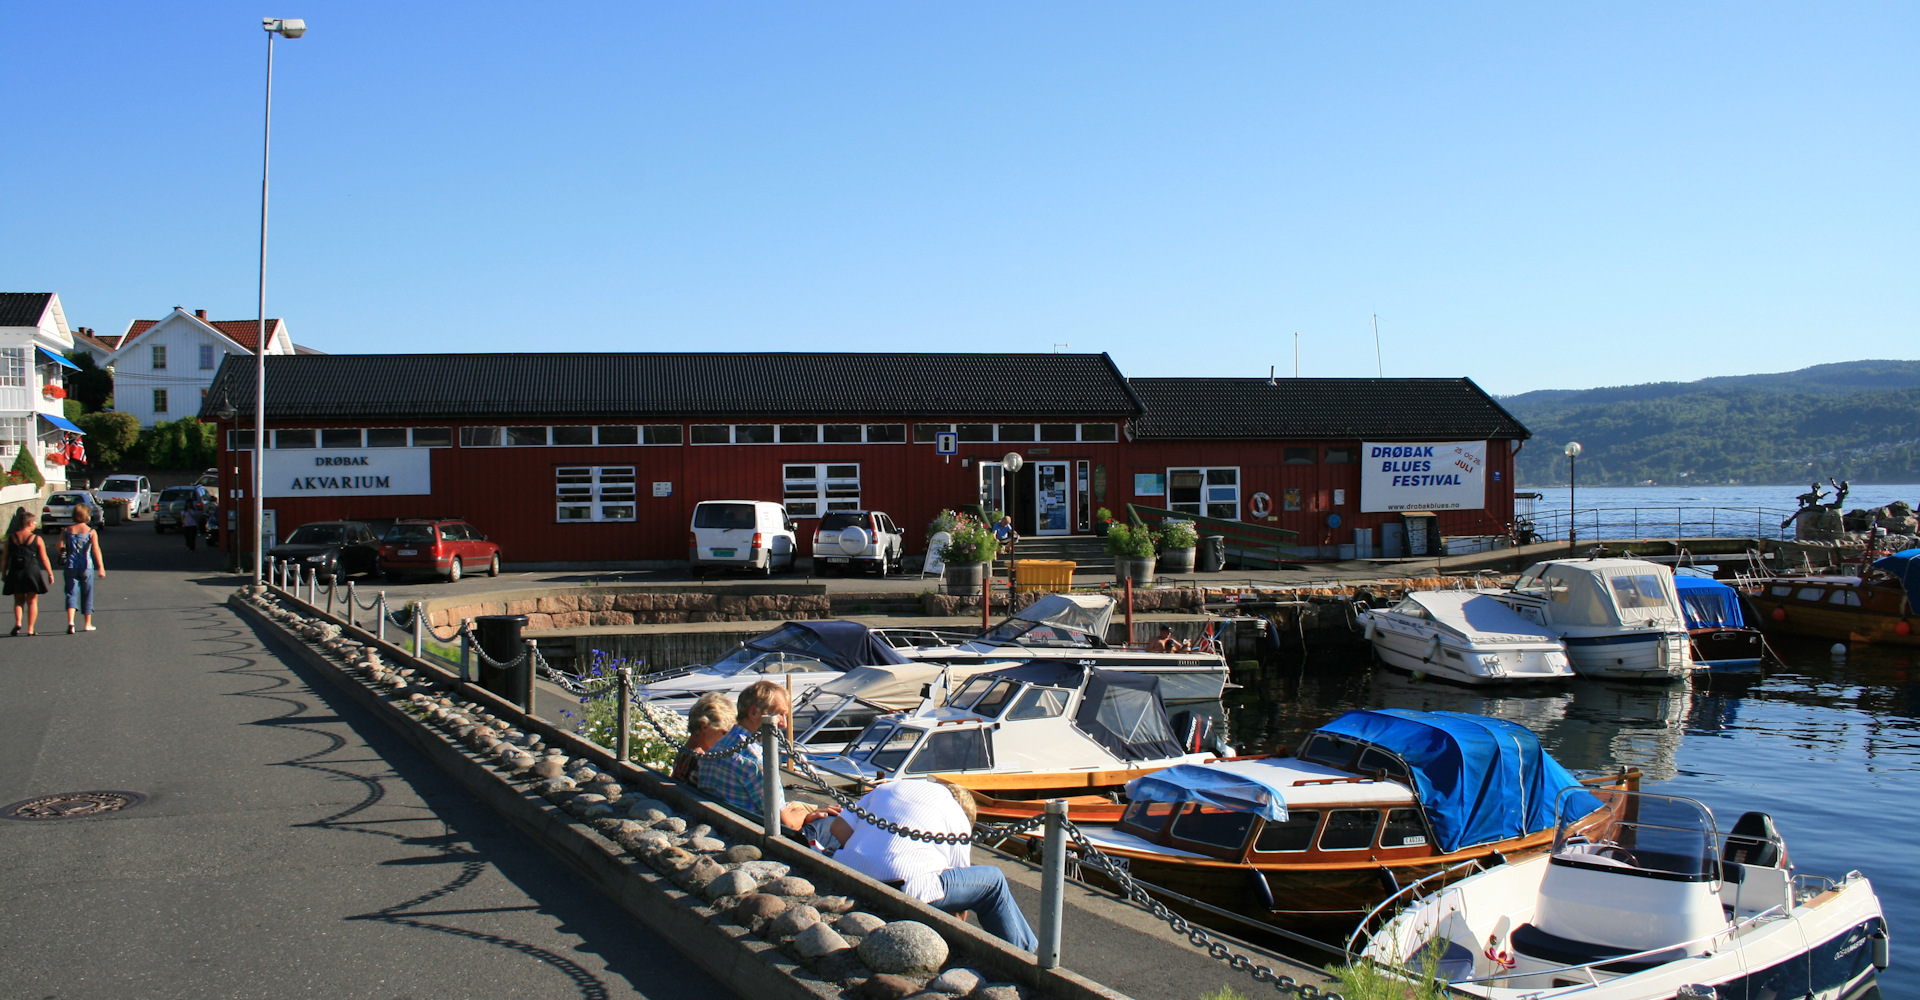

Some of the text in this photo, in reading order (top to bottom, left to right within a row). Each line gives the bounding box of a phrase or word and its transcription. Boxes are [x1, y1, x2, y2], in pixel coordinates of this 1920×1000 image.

[1371, 446, 1434, 459] DRØBAK
[1463, 452, 1473, 461] OG
[315, 456, 369, 466] DRØBAK
[1382, 461, 1431, 473] BLUES
[1454, 459, 1474, 473] JULI
[291, 476, 390, 490] AKVARIUM
[1392, 474, 1461, 487] FESTIVAL
[1387, 503, 1460, 511] www.drobakblues.no
